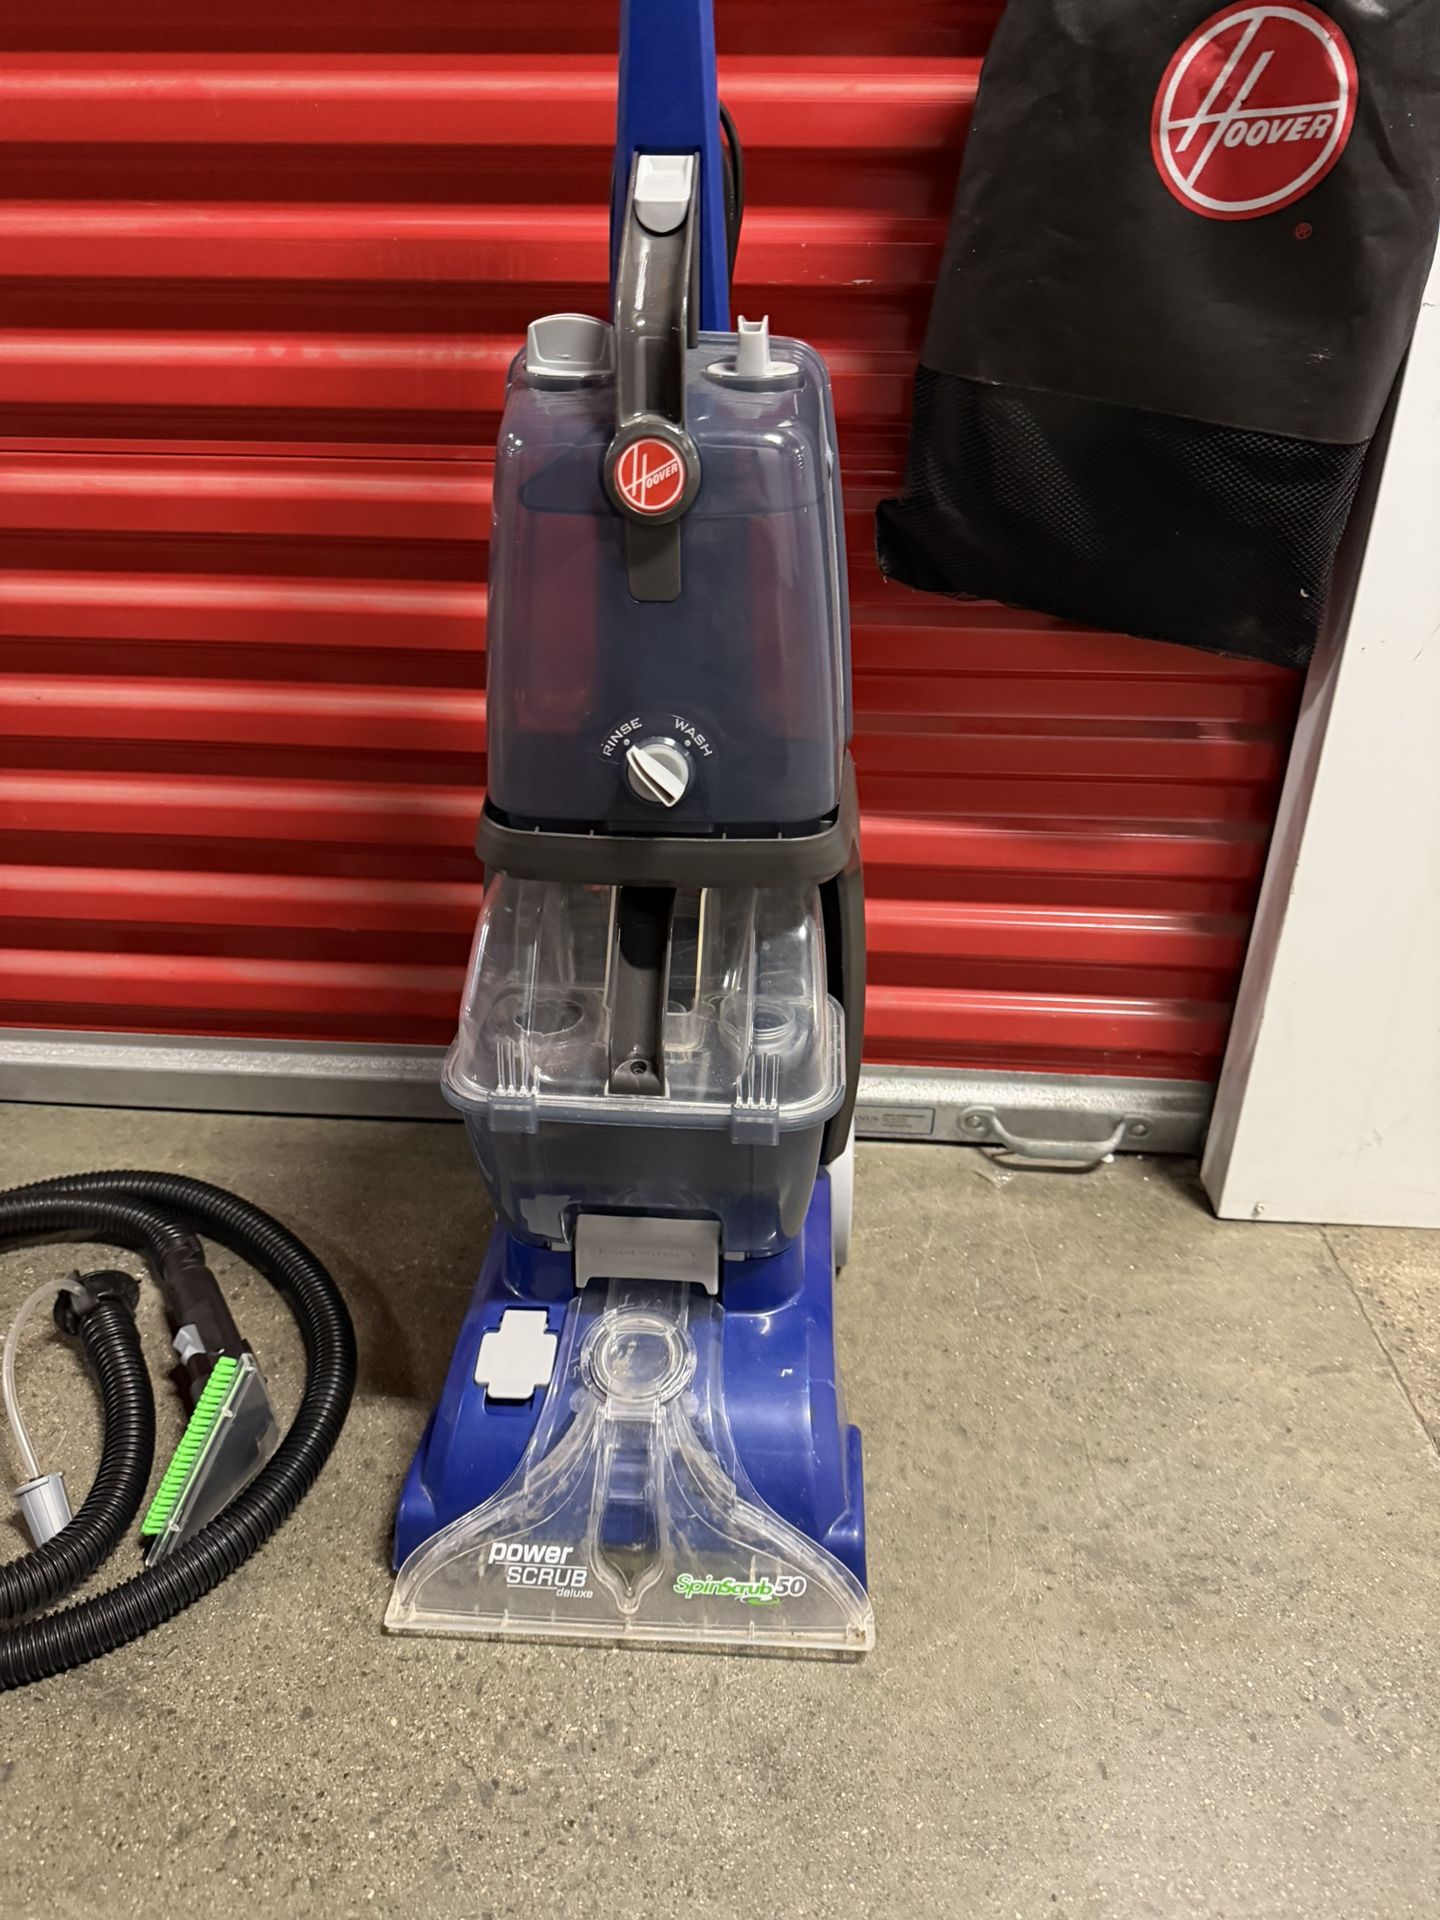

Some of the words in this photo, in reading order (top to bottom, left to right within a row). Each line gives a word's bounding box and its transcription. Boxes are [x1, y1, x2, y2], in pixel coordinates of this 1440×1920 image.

[1167, 15, 1342, 188] HOOVER
[623, 444, 681, 506] HOOVER
[602, 717, 643, 757] RINSE
[674, 718, 713, 757] WASH
[487, 1542, 574, 1565] power
[506, 1566, 588, 1588] SCRUB
[556, 1587, 594, 1599] deluxe
